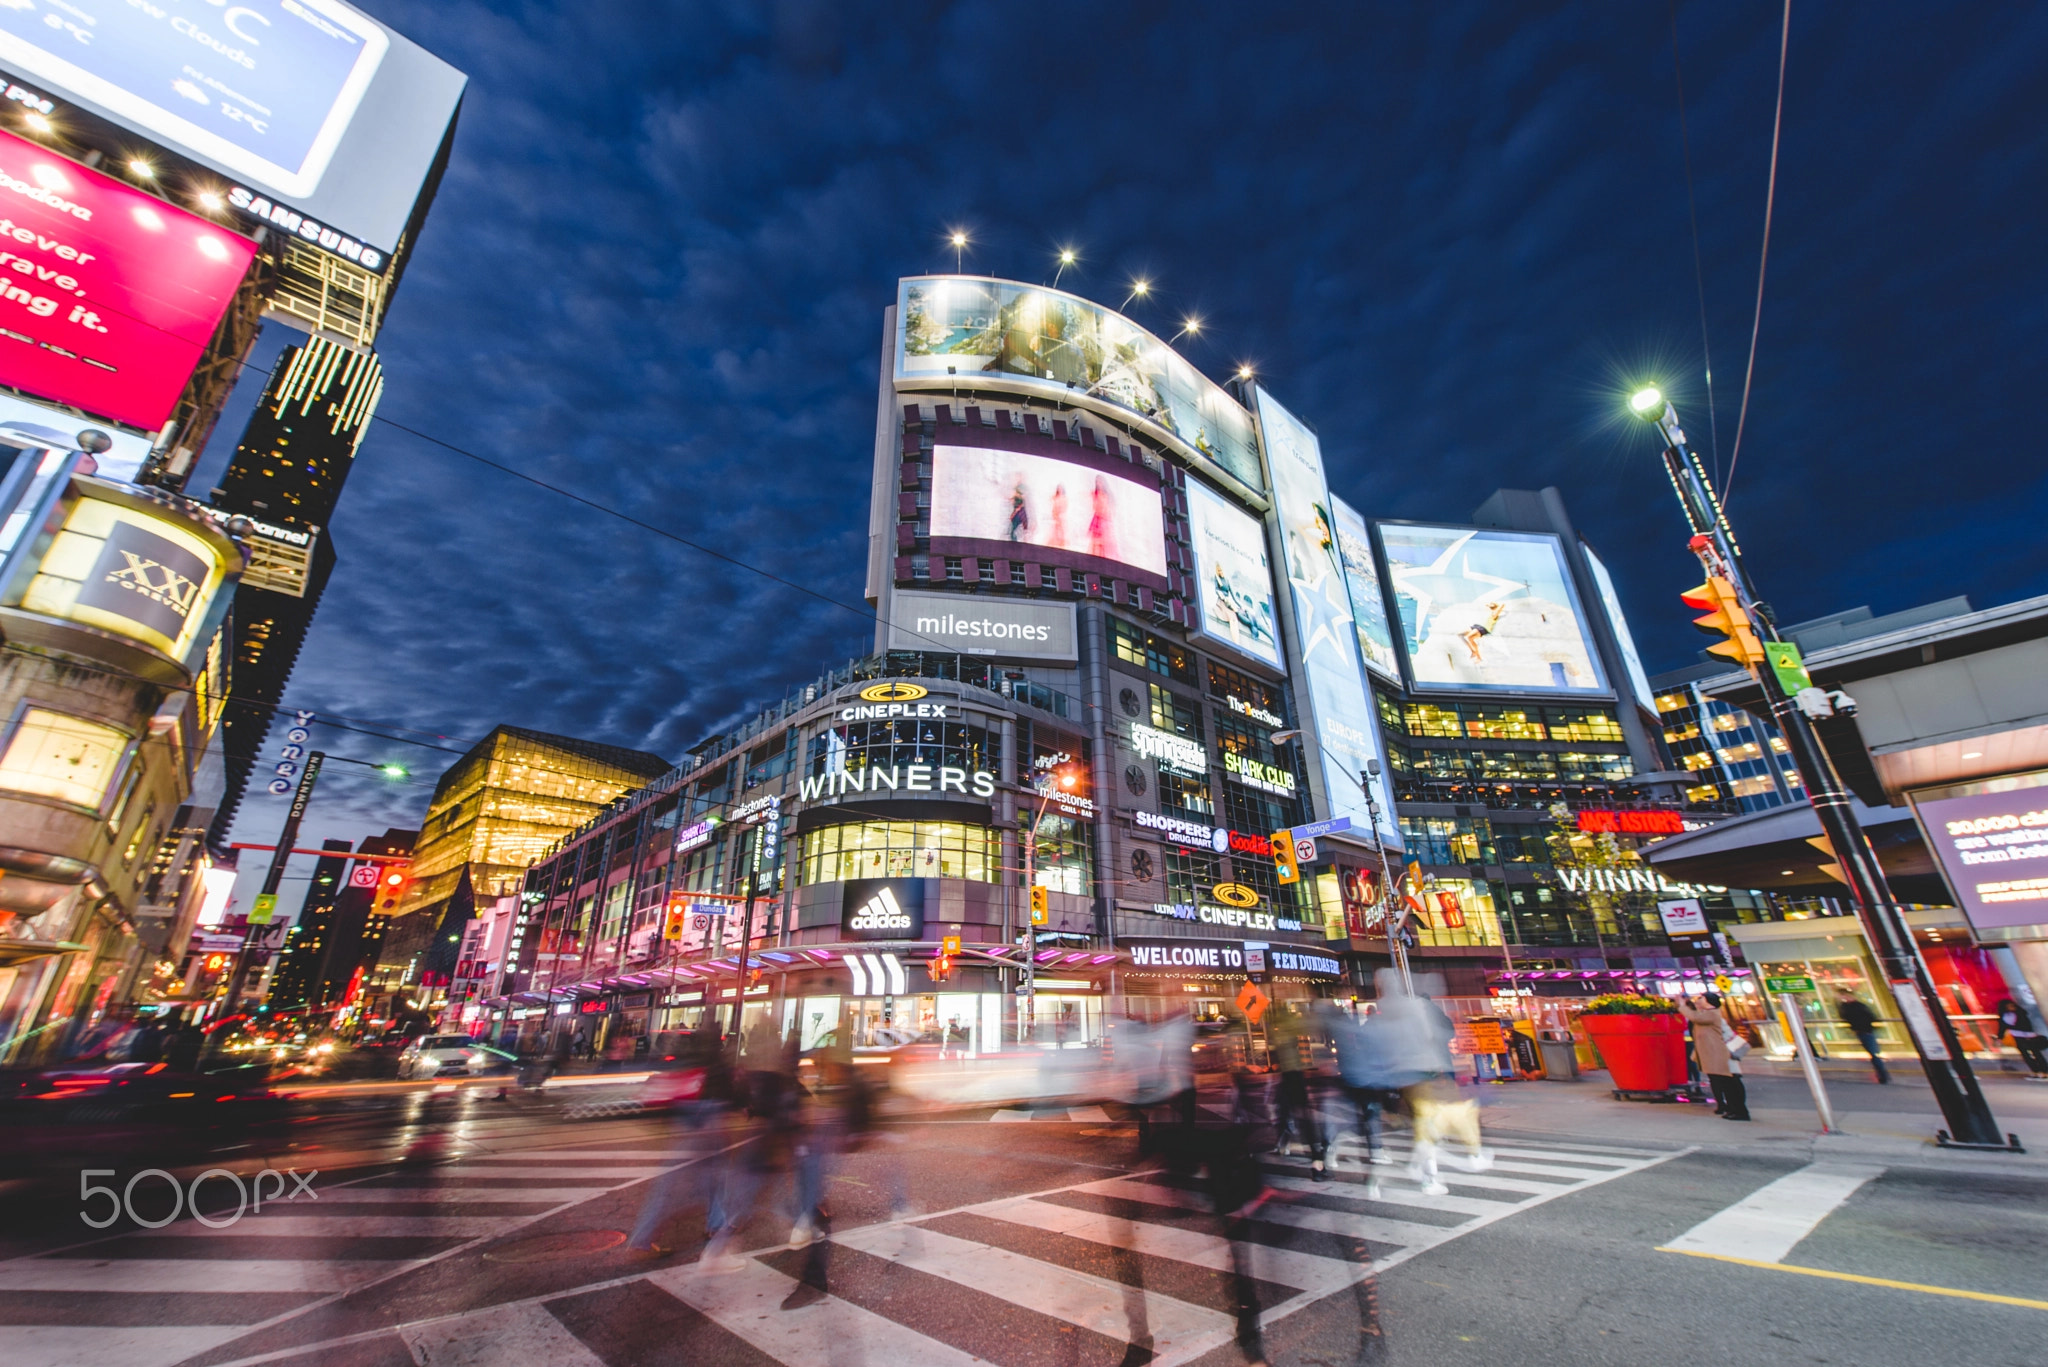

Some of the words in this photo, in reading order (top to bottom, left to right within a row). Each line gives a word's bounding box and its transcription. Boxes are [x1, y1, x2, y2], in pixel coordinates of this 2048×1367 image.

[228, 186, 383, 269] SAMSUNG
[67, 304, 108, 334] it.
[110, 549, 199, 610] XXI
[105, 574, 188, 617] FOREVER
[917, 614, 1049, 641] milestones
[841, 704, 946, 721] CINEPLEX
[1326, 717, 1366, 746] EUROPE
[799, 765, 995, 802] WINNERS
[1224, 752, 1266, 781] SHARK
[1266, 766, 1296, 791] CLUB
[290, 756, 320, 818] DOWNTOWN
[1039, 786, 1094, 810] milestones
[681, 824, 699, 843] SHARK
[1135, 811, 1212, 838] SHOPPERS
[1304, 823, 1331, 836] Yonge
[1577, 810, 1620, 833] JACK
[1619, 810, 1684, 834] ASTOR'S
[753, 825, 764, 872] DOWNTOWN
[1168, 832, 1192, 844] DRUG
[1190, 837, 1212, 849] MART
[851, 912, 911, 930] adidas
[1200, 906, 1276, 931] CINEPLEX
[1277, 918, 1302, 931] IMAX
[506, 892, 534, 974] WINNERS
[1130, 946, 1220, 967] WELCOME
[1221, 950, 1242, 967] TO
[1272, 952, 1297, 970] TEN
[1298, 955, 1330, 973] DUNDAS
